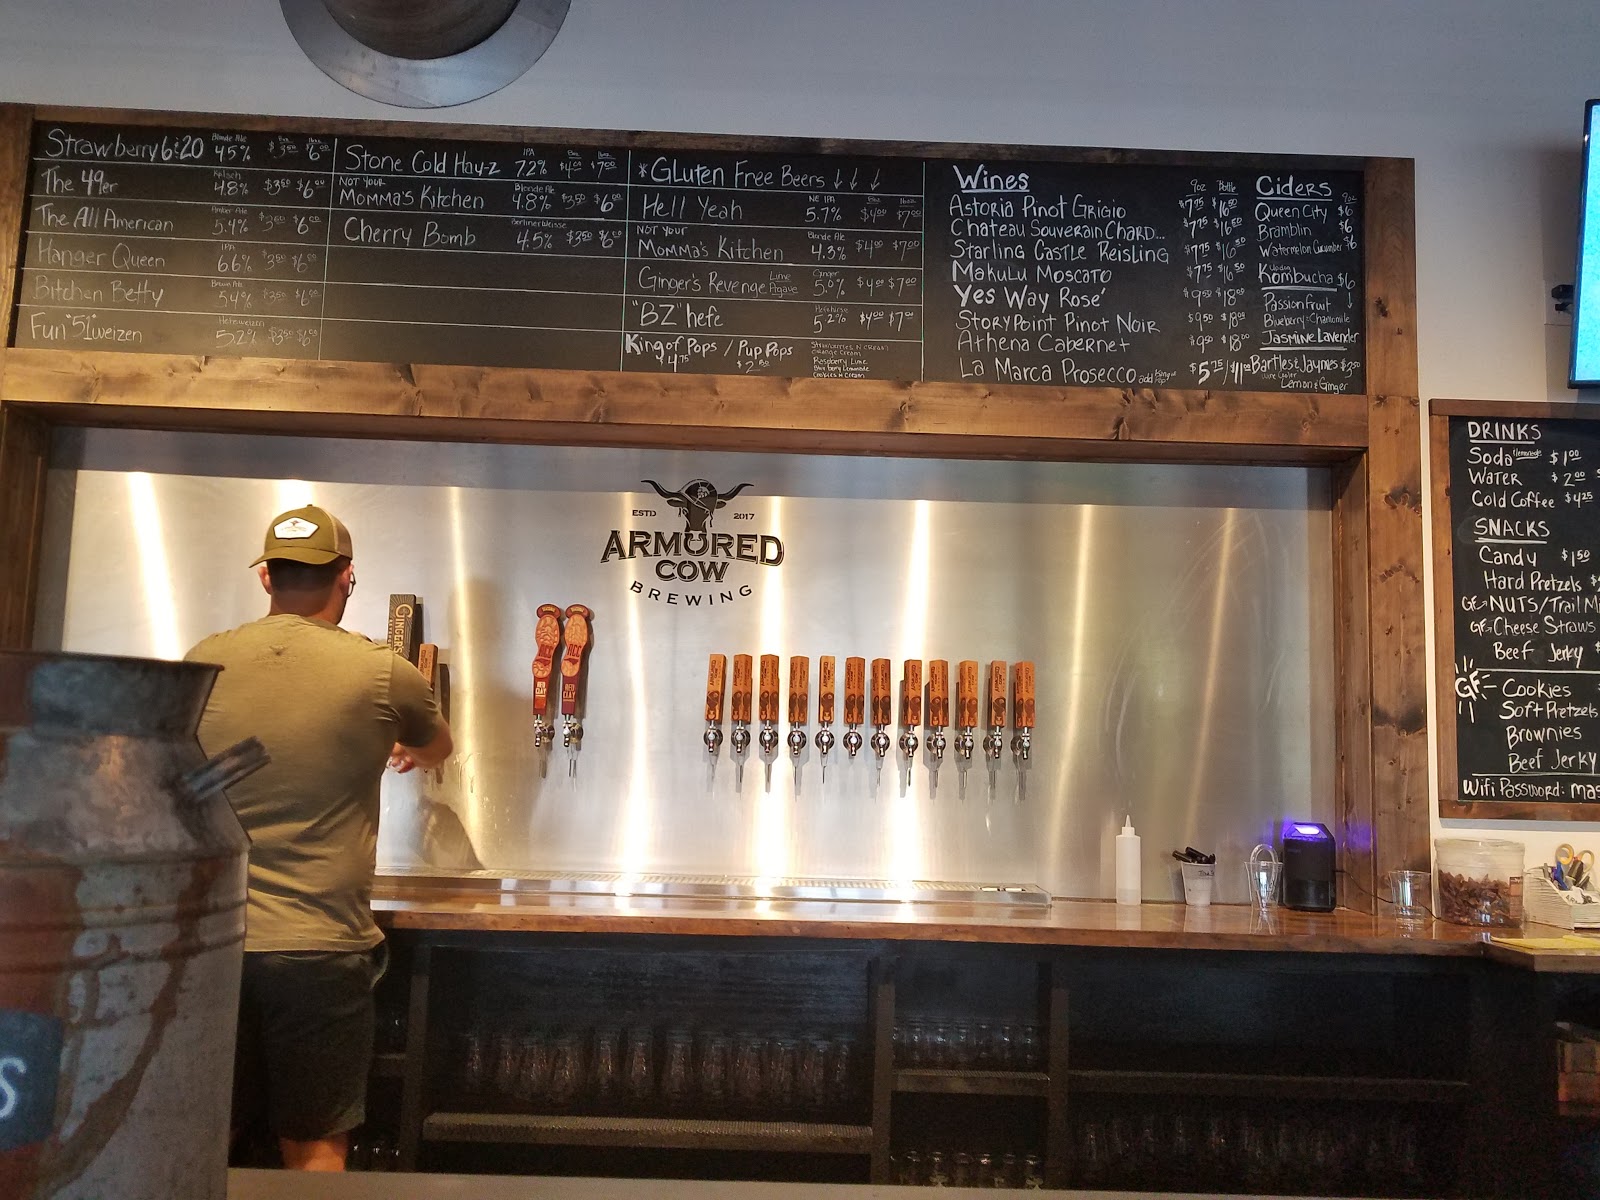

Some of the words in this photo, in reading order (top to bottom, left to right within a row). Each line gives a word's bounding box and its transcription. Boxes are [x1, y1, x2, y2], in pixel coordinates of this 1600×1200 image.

[345, 144, 403, 173] Stone
[412, 150, 446, 175] Cold
[522, 148, 535, 157] IPA
[515, 159, 548, 178] 7.2%
[734, 160, 774, 189] Free
[781, 164, 825, 189] Beers
[952, 163, 1030, 190] Wines
[41, 165, 74, 194] The
[81, 168, 118, 196] 49er
[214, 180, 249, 196] 4.8%
[339, 176, 360, 187] NOT
[363, 176, 385, 187] YOUR
[514, 183, 544, 192] Blonde
[1190, 178, 1206, 193] 9oz
[419, 184, 484, 210] Kitchen
[512, 193, 552, 212] 4.8%
[642, 192, 686, 220] Hell
[697, 194, 742, 220] Yeah
[808, 195, 820, 203] NE
[824, 195, 836, 204] IPA
[1022, 194, 1067, 219] Pinot
[35, 203, 70, 227] The
[75, 207, 100, 228] All
[103, 208, 174, 232] American
[804, 206, 842, 223] 5.7%
[1254, 202, 1301, 221] Queen
[1302, 205, 1328, 223] City
[1337, 205, 1354, 218] $6
[211, 218, 249, 236] 5.4%
[343, 216, 412, 246] Cherry
[423, 220, 476, 247] Bomb
[635, 224, 659, 236] NOT
[662, 226, 688, 236] YOUR
[807, 231, 832, 240] Blonde
[833, 232, 846, 241] Ale
[950, 218, 1026, 237] Chateau
[1256, 222, 1312, 242] Bramblin
[1338, 219, 1353, 234] $6
[516, 229, 553, 251] 4.5%
[717, 235, 784, 262] Kitchen
[1259, 242, 1312, 258] Watermelon
[1343, 234, 1358, 252] $6
[38, 237, 107, 268] Hanger
[111, 243, 165, 269] Queen
[811, 242, 847, 261] 4.3%
[217, 253, 252, 273] 6.6%
[638, 265, 702, 296] Ginger's
[708, 270, 769, 298] Revenge
[768, 270, 792, 282] Lime
[1258, 262, 1334, 284] Kombucha
[1336, 272, 1356, 290] $6
[31, 274, 103, 302] Bitchen
[110, 280, 164, 307] Betty
[813, 278, 846, 299] 5.0%
[952, 283, 996, 308] Yes
[1003, 284, 1050, 313] Way
[1263, 291, 1305, 312] Passion
[631, 300, 683, 327] "BZ"
[686, 304, 724, 329] hefe
[1064, 311, 1110, 333] Pinot
[30, 312, 67, 341] Fun
[1317, 327, 1359, 344] Lavender
[215, 328, 257, 349] 5.2%
[625, 333, 665, 360] King
[665, 335, 685, 351] of
[687, 339, 718, 358] Pops
[737, 339, 763, 359] Pup
[765, 343, 794, 362] Pops
[957, 329, 1030, 353] Athena
[813, 356, 848, 367] Raspberry
[850, 357, 868, 365] Lime
[959, 356, 984, 378] La
[995, 357, 1052, 383] Marca
[1061, 357, 1137, 385] Prosecco
[1138, 373, 1153, 385] add
[1249, 354, 1294, 375] Bartles
[1300, 354, 1339, 373] Jaymes
[1280, 377, 1313, 389] Lemon
[1318, 376, 1349, 395] Ginger
[1467, 421, 1542, 441] DRINKS
[1466, 446, 1513, 467] Soda
[1471, 489, 1507, 509] Cold
[1510, 490, 1556, 509] Coffee
[632, 509, 657, 517] ESTD
[733, 512, 755, 520] 2017
[1473, 517, 1550, 537] SNACKS
[600, 529, 785, 567] ARMORED
[1478, 545, 1537, 567] Candy
[655, 559, 730, 583] COW
[1483, 569, 1525, 591] Hard
[1530, 570, 1582, 593] Pretzels
[630, 580, 753, 606] BREWING
[1470, 618, 1488, 637] GF
[1493, 616, 1540, 636] Cheese
[1543, 615, 1596, 635] Straws
[1493, 640, 1535, 660] Beef
[1547, 642, 1584, 669] Jerky
[535, 687, 547, 695] CLAY
[562, 691, 576, 699] CLAY
[1454, 669, 1480, 702] GF
[1502, 678, 1572, 699] Cookies
[1499, 700, 1544, 720] Soft
[1546, 699, 1599, 725] Pretzels
[1505, 725, 1582, 751] Brownies
[1508, 748, 1544, 774] Beef
[1550, 748, 1597, 774] Jerky
[1463, 778, 1496, 797] Wifi
